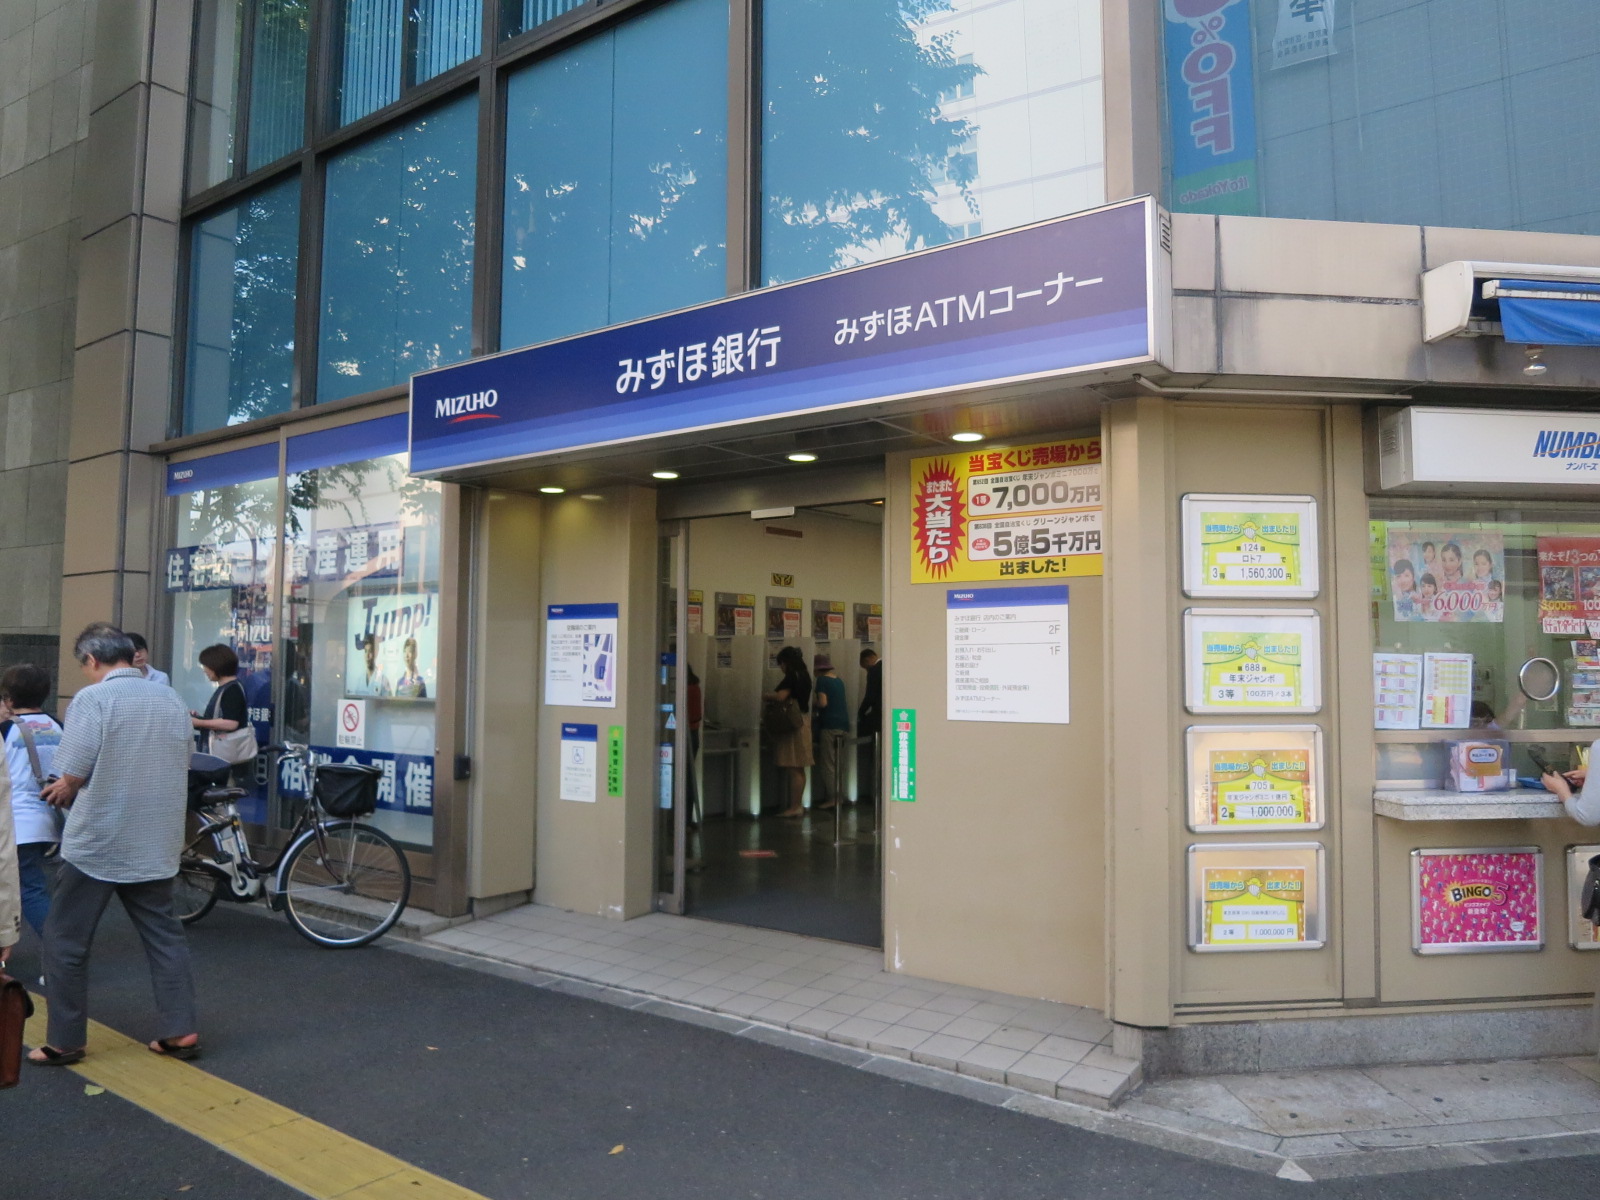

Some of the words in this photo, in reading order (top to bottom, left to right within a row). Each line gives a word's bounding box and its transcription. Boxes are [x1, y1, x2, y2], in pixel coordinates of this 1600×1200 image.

[834, 271, 1103, 345] みずほATMコーナー
[615, 325, 782, 394] みずほ銀行
[435, 389, 498, 419] MIZUHO
[968, 440, 1102, 473] 当宝くじ売場から
[1566, 462, 1599, 470] ナンバーズ
[173, 469, 193, 481] MIZUHO
[926, 480, 953, 494] またまた
[992, 481, 1101, 511] 7,000万円
[1033, 514, 1096, 526] グリーンジャンボで
[925, 494, 952, 564] 大当たり
[993, 528, 1101, 557] 5億5千万円
[355, 593, 432, 651] Jump!
[1049, 625, 1061, 635] 2F
[1050, 646, 1061, 656] 1F
[1229, 674, 1275, 683] 年末ジャンボ
[1218, 689, 1235, 699] 3等
[1451, 886, 1491, 902] BINGO
